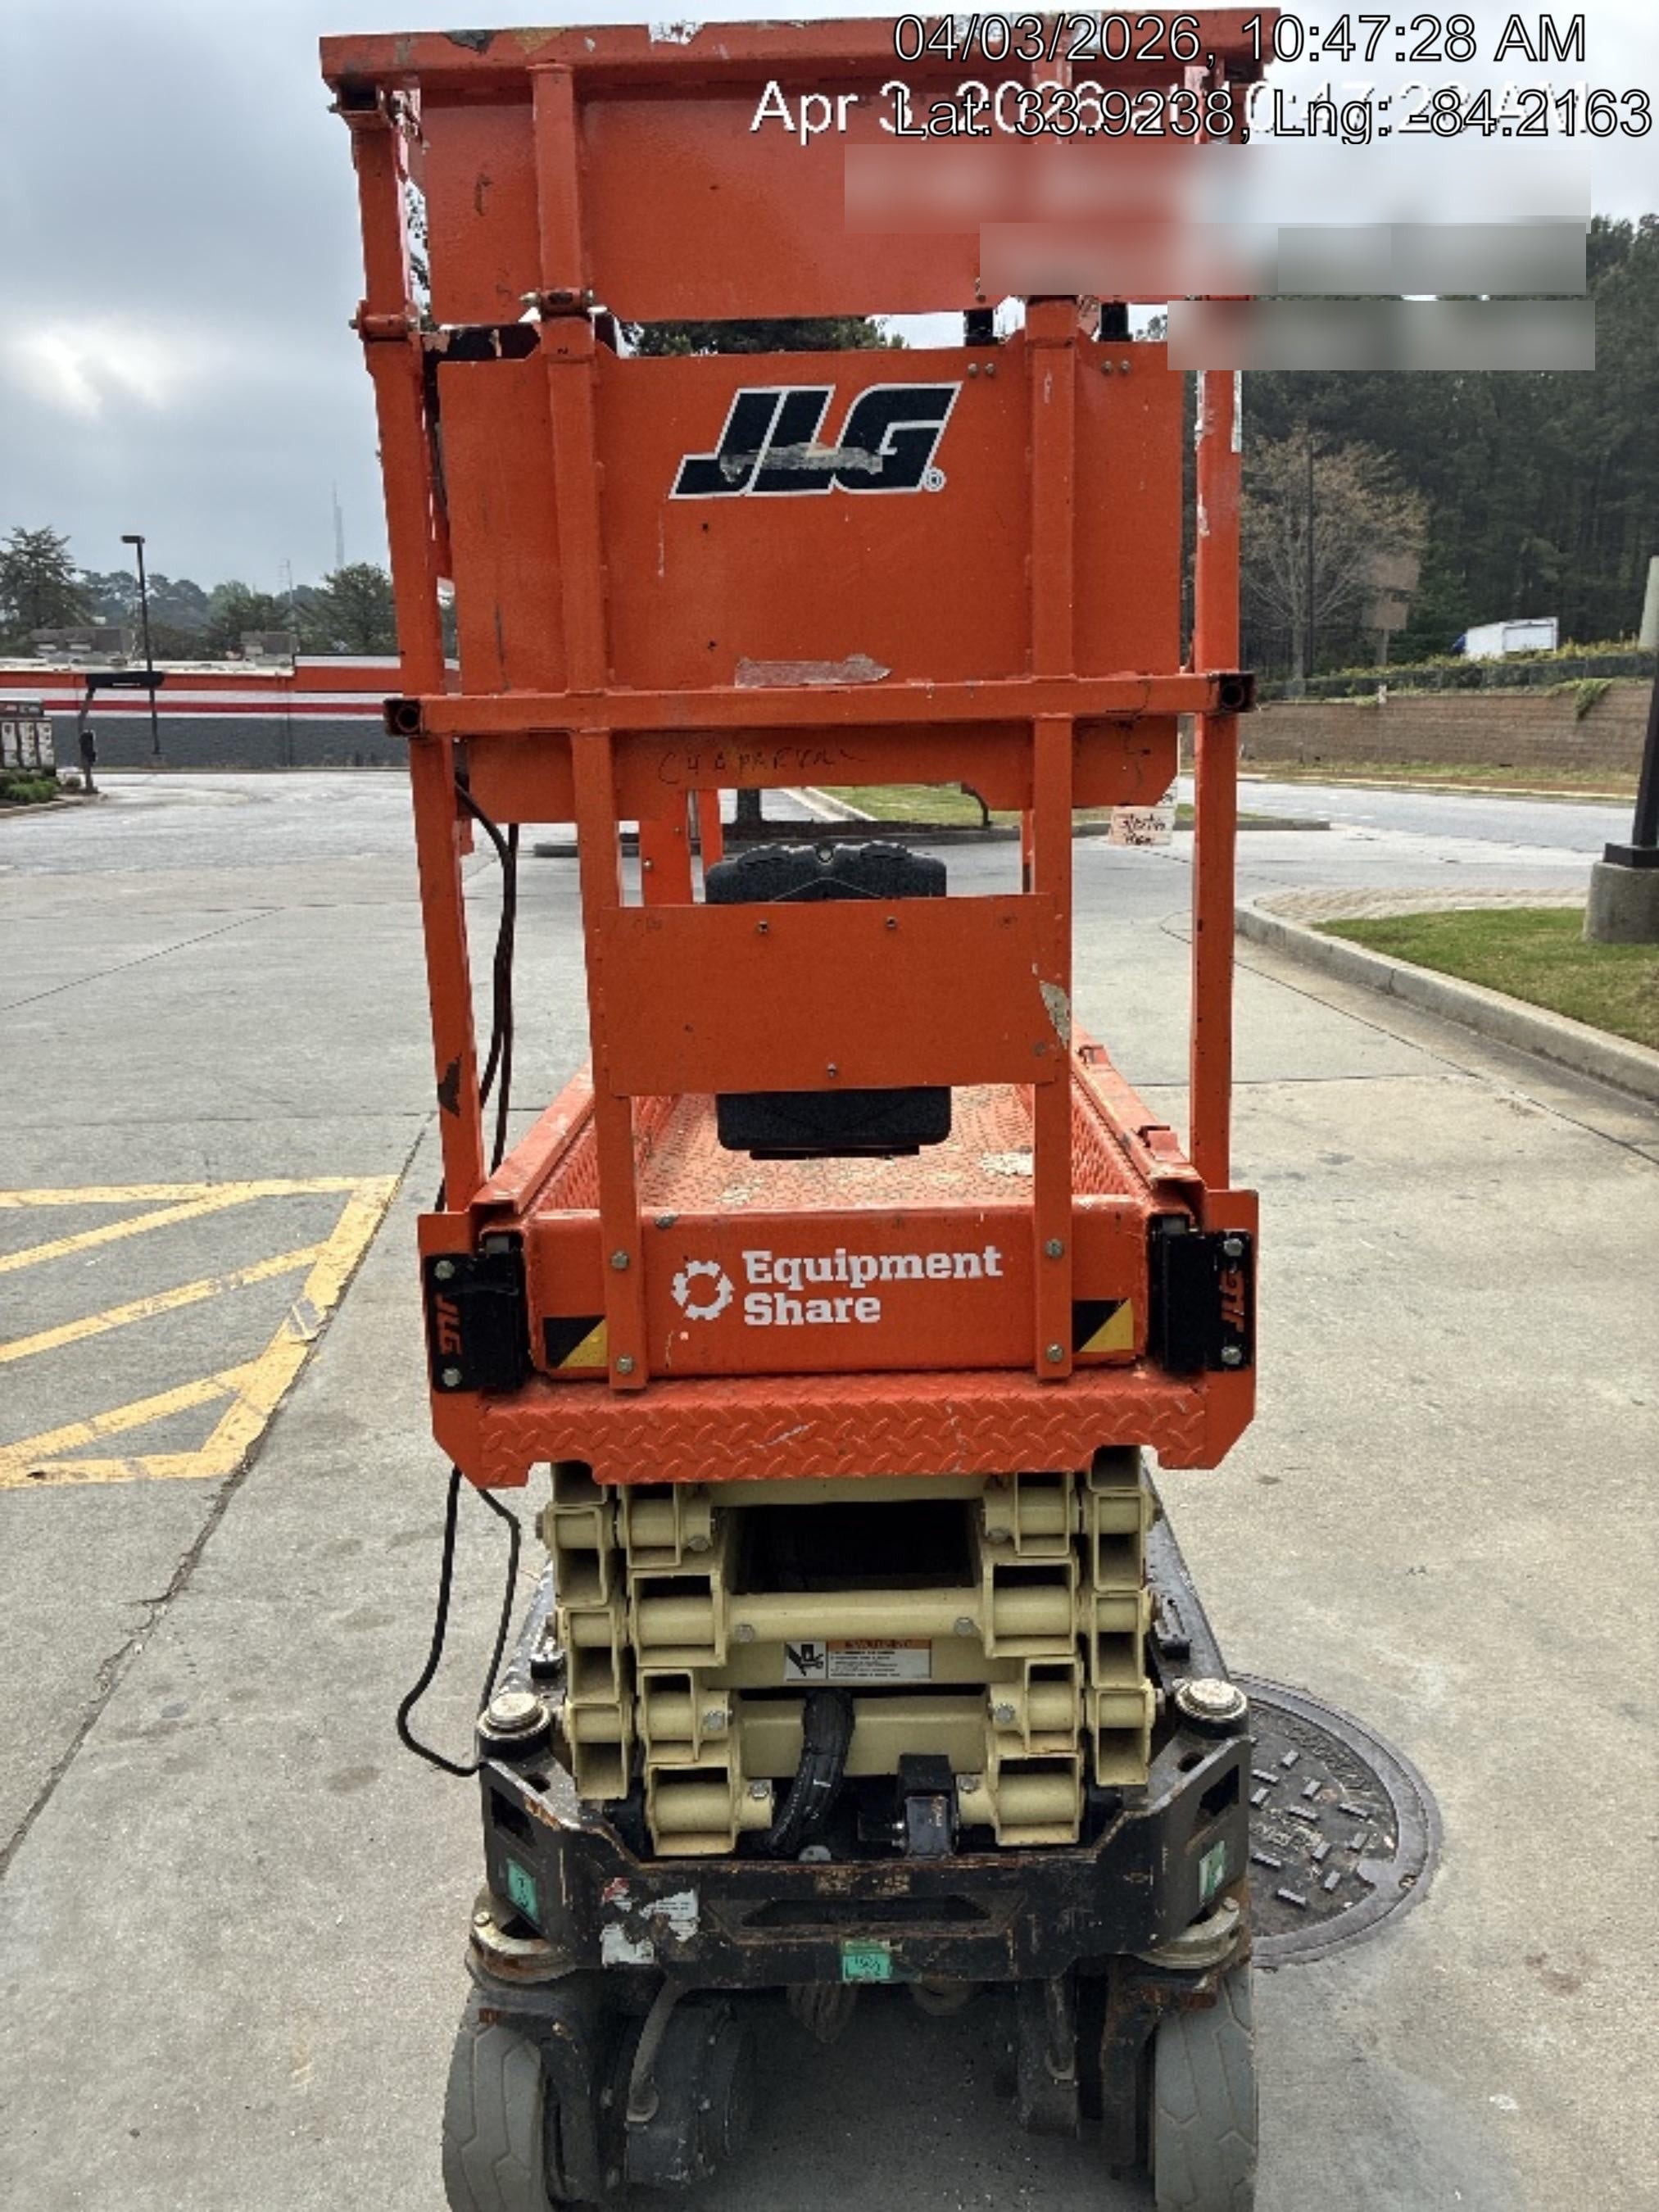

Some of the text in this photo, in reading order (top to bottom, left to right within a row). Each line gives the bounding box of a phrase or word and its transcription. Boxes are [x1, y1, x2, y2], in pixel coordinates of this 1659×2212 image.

[669, 381, 963, 499] JLG
[741, 1245, 1003, 1290] Equipment
[436, 1294, 462, 1354] JLG
[744, 1292, 881, 1326] Share
[1220, 1269, 1244, 1332] JLG
